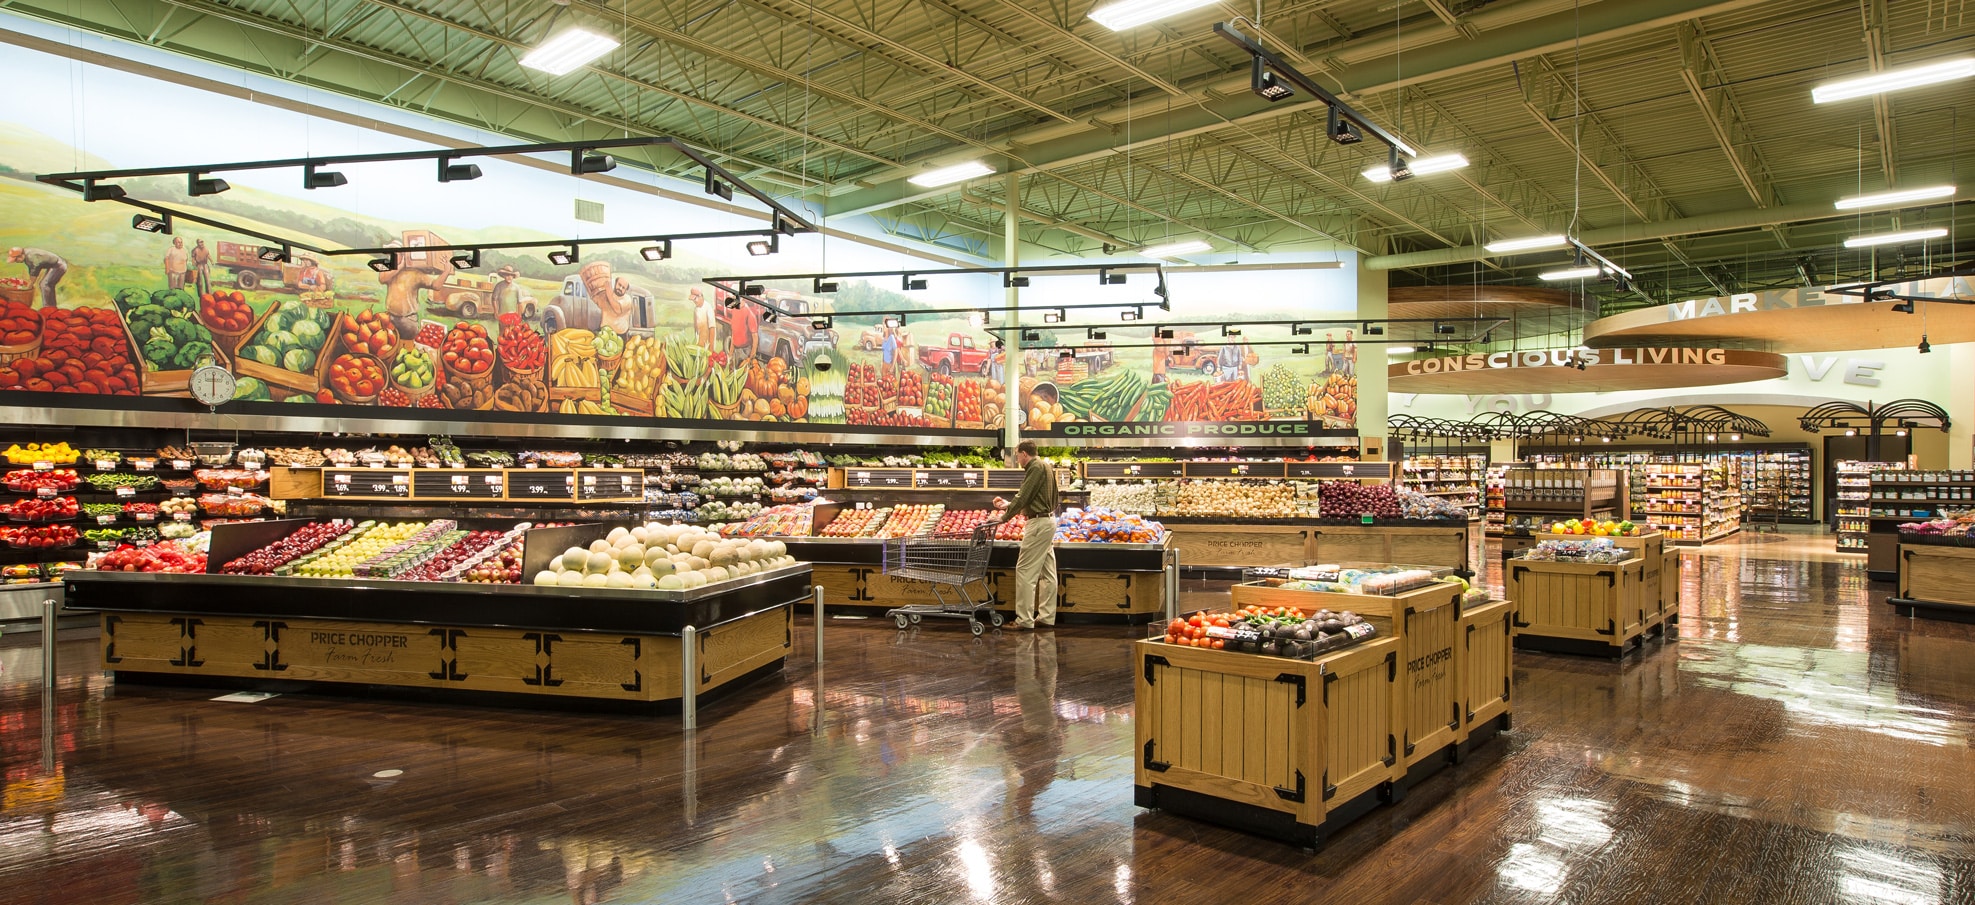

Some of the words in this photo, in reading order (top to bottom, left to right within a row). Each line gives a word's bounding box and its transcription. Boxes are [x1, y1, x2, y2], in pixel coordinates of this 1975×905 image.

[1407, 346, 1600, 375] CONSCIOUS
[1614, 347, 1726, 365] LIVING
[1063, 425, 1175, 435] ORGANIC
[1187, 424, 1309, 434] PRODUCE
[1207, 540, 1228, 548] PRICE
[310, 631, 345, 645] PRICE
[349, 633, 408, 648] CHOPPER
[326, 646, 358, 664] Farm
[361, 647, 395, 665] Fresh
[1407, 656, 1425, 675] PRICE
[1425, 646, 1452, 668] CHOPPER
